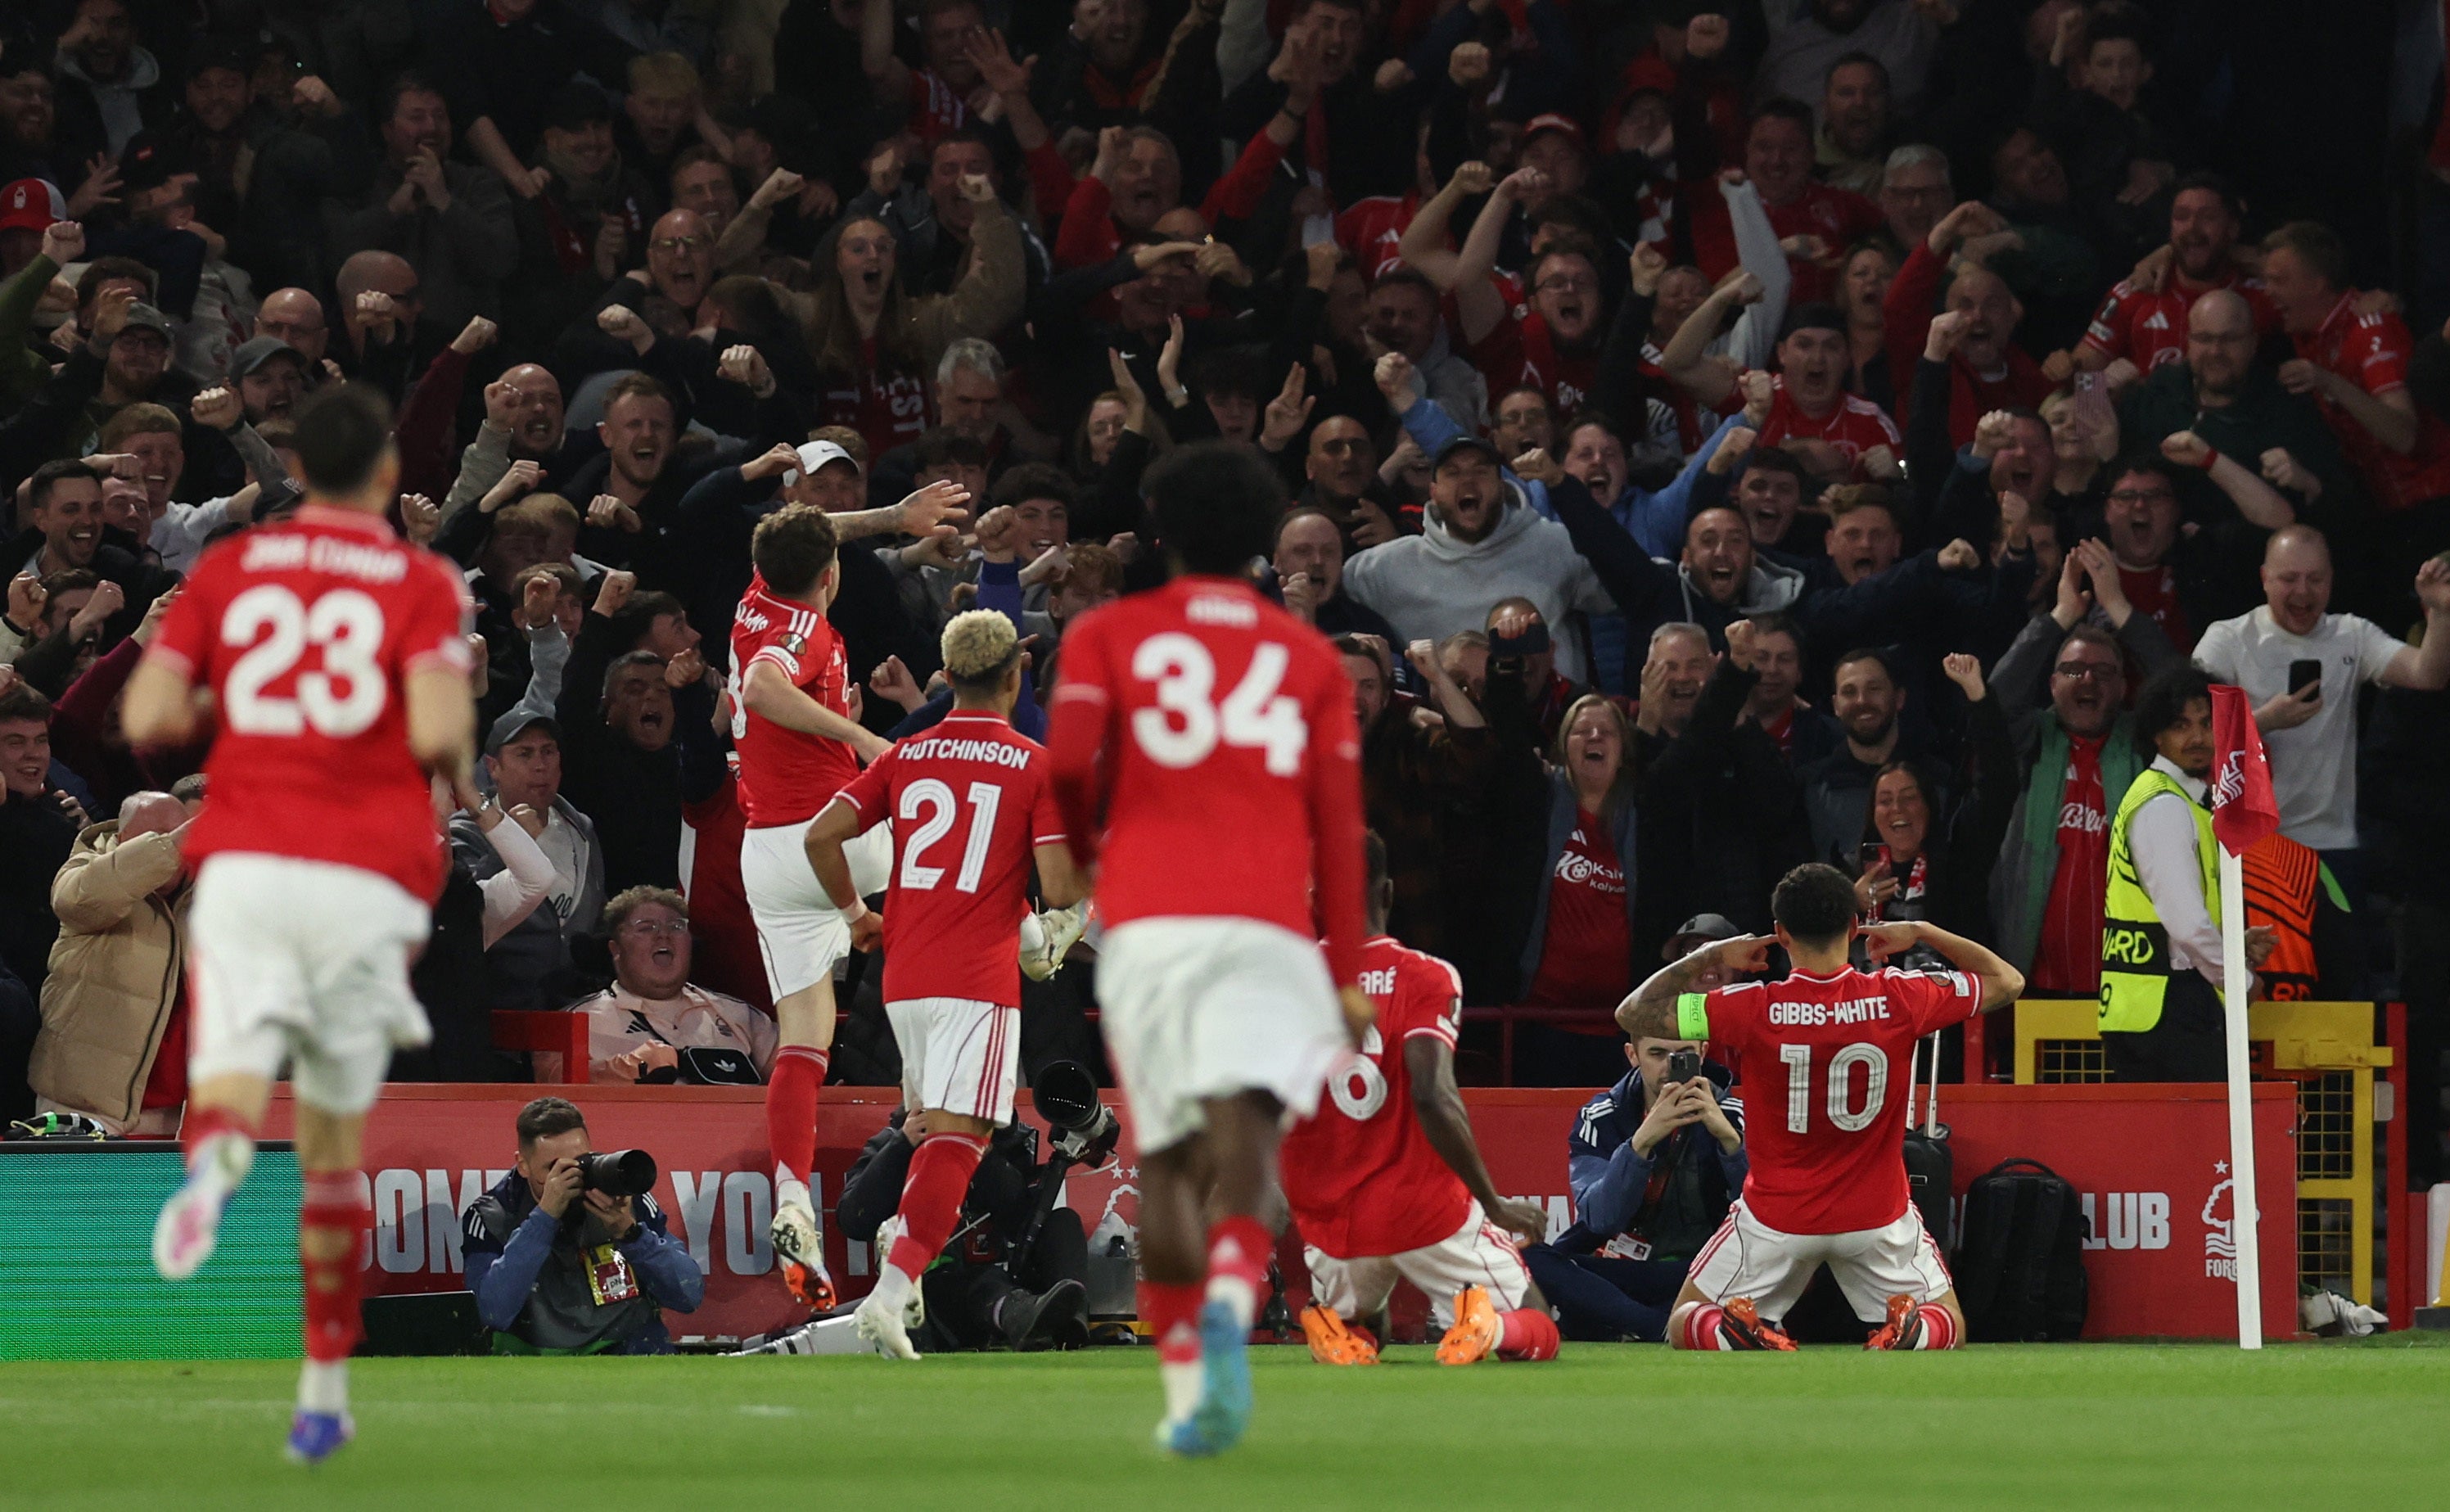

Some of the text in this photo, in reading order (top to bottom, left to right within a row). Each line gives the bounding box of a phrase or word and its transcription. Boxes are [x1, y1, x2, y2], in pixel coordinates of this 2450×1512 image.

[221, 584, 388, 738] 23
[1131, 631, 1308, 775] 34
[898, 738, 1031, 770] HUTCHINSON
[900, 778, 1002, 894] 21
[1769, 995, 1890, 1026] GIBBS-WHITE
[1780, 1042, 1888, 1134] 10
[670, 1171, 824, 1275] YO
[2082, 1192, 2170, 1250] LUB
[2205, 1258, 2237, 1282] FORE
